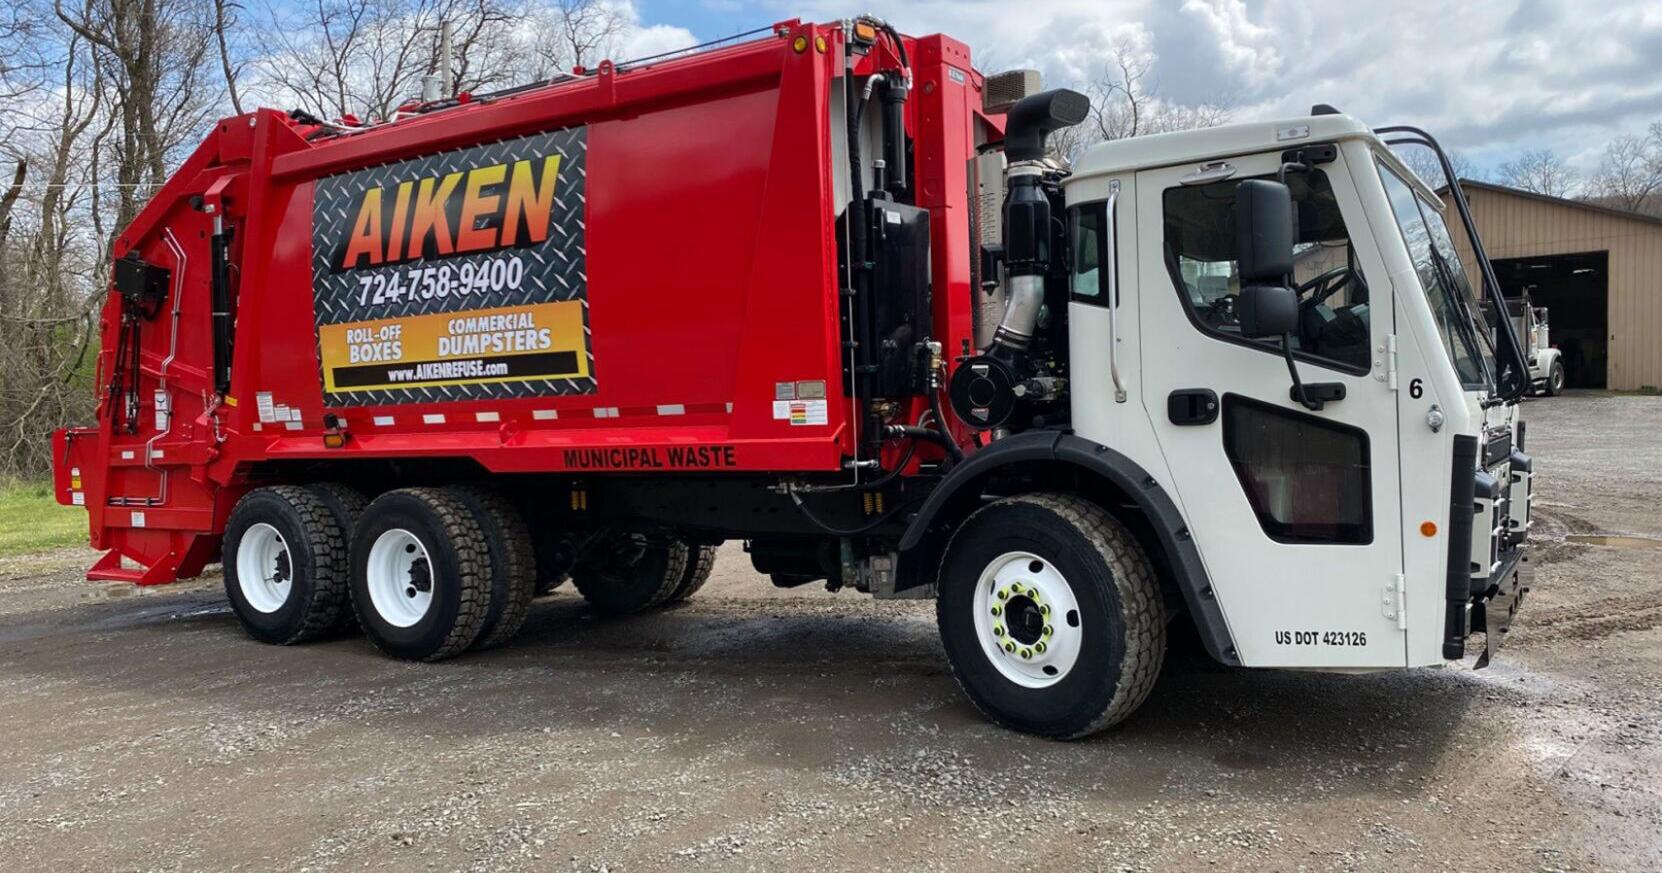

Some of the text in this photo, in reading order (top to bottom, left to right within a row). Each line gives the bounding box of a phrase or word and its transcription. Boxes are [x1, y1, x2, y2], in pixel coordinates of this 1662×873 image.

[342, 154, 562, 269] AIKEN
[359, 256, 524, 306] 724-758-9400
[346, 325, 402, 344] ROLL-OFF
[448, 312, 535, 335] COMMERCIAL
[350, 342, 402, 364] BOXES
[438, 328, 551, 357] DUMPSTERS
[388, 360, 508, 382] www.AIKENREFUSE.com
[1409, 378, 1423, 399] 6
[563, 446, 737, 468] MUNICIPAL WASTE
[1275, 631, 1367, 646] US DOT 423126
